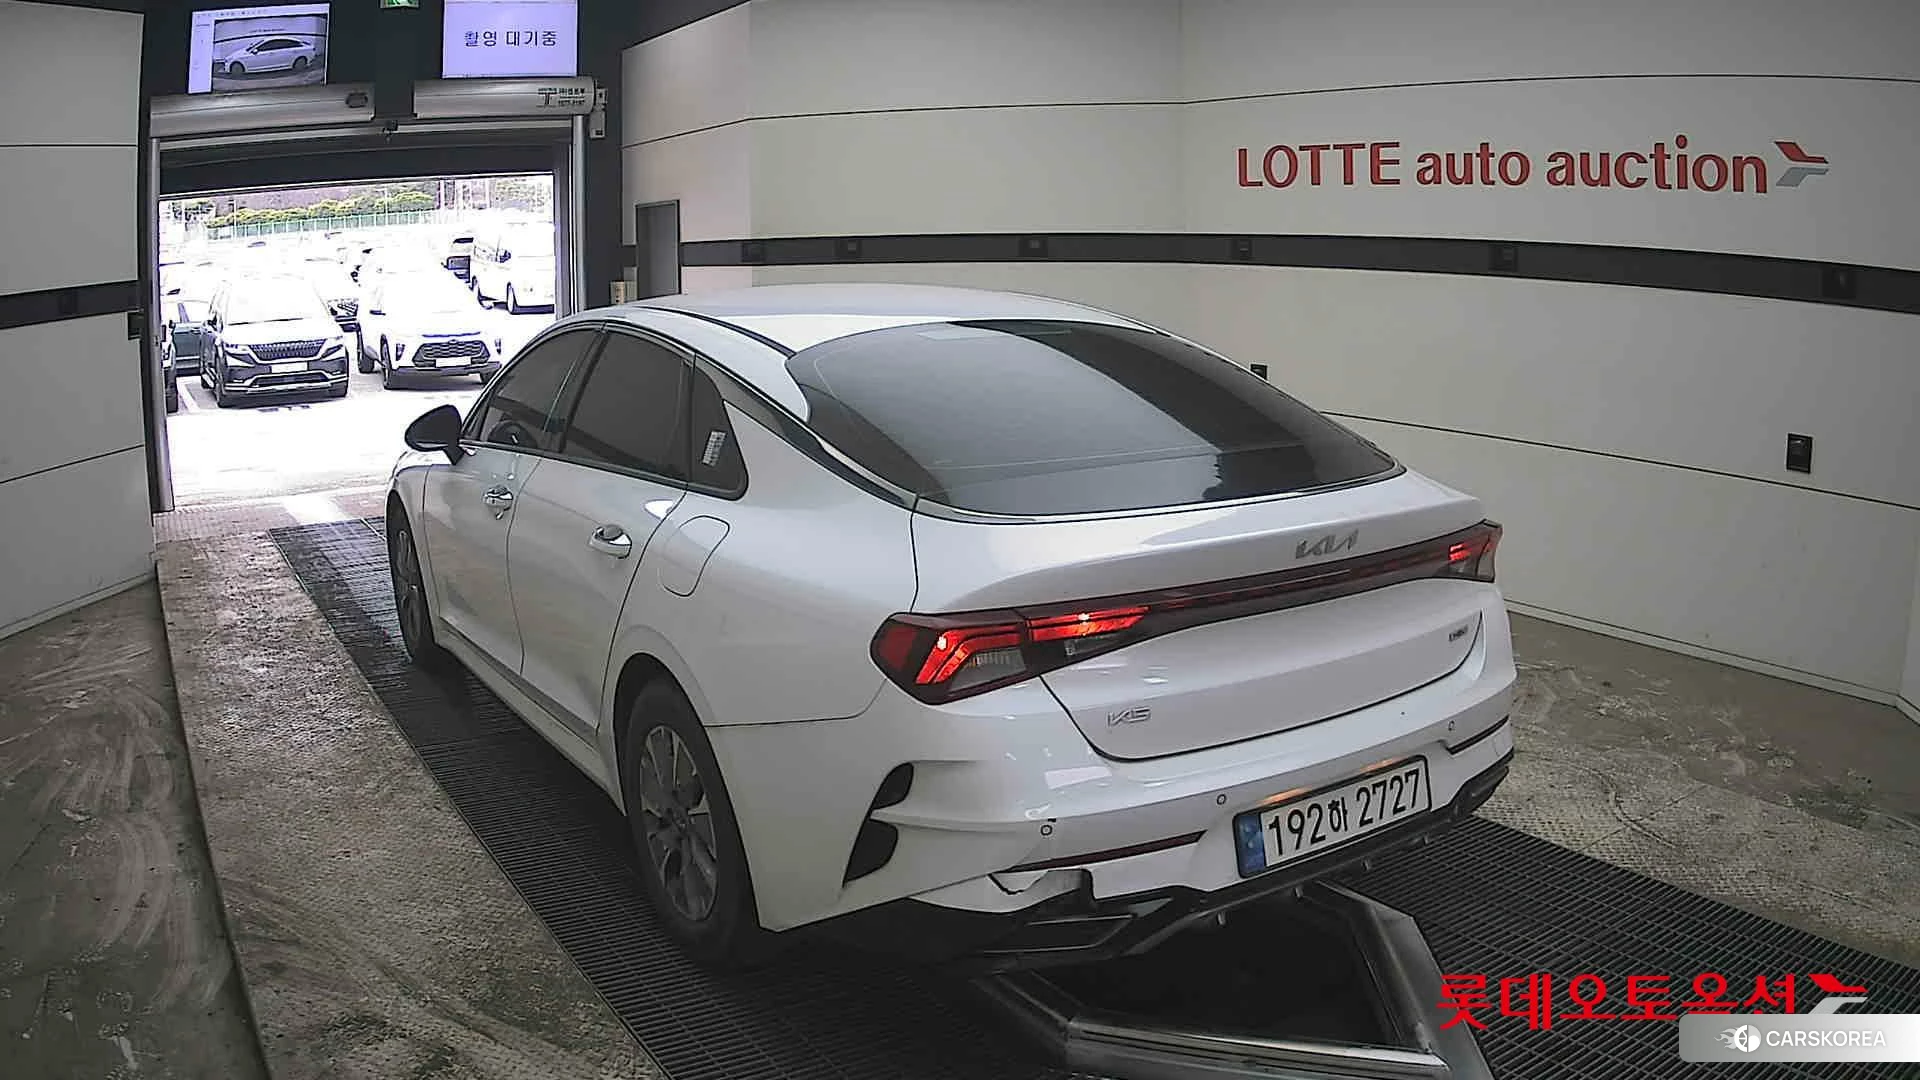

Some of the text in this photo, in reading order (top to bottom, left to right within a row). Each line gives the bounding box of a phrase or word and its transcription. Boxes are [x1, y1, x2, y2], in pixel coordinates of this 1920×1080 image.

[505, 31, 557, 47] 대기중
[1238, 134, 1768, 194] LOTTE auto auction
[1107, 706, 1152, 727] K5
[1268, 768, 1420, 856] 192하 2727
